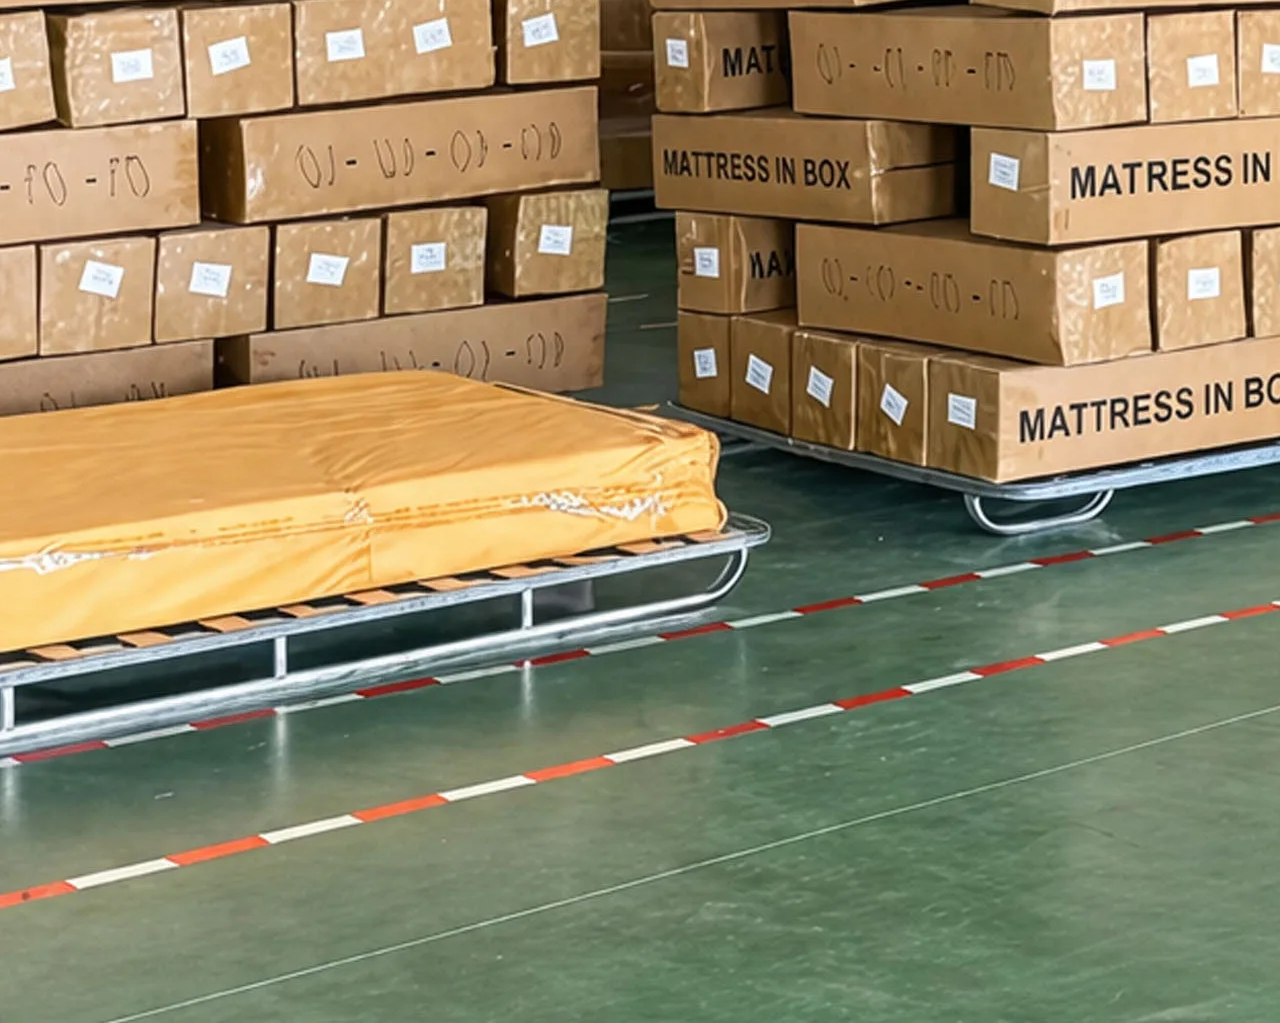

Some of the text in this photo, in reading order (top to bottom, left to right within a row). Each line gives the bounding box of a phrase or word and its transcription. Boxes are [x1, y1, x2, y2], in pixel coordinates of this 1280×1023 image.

[663, 149, 851, 190] MATTRESS IN BOX
[1070, 155, 1233, 200] MATRESS
[1242, 152, 1271, 184] IN
[1018, 386, 1194, 443] MATTRESS
[1204, 381, 1233, 415] IN
